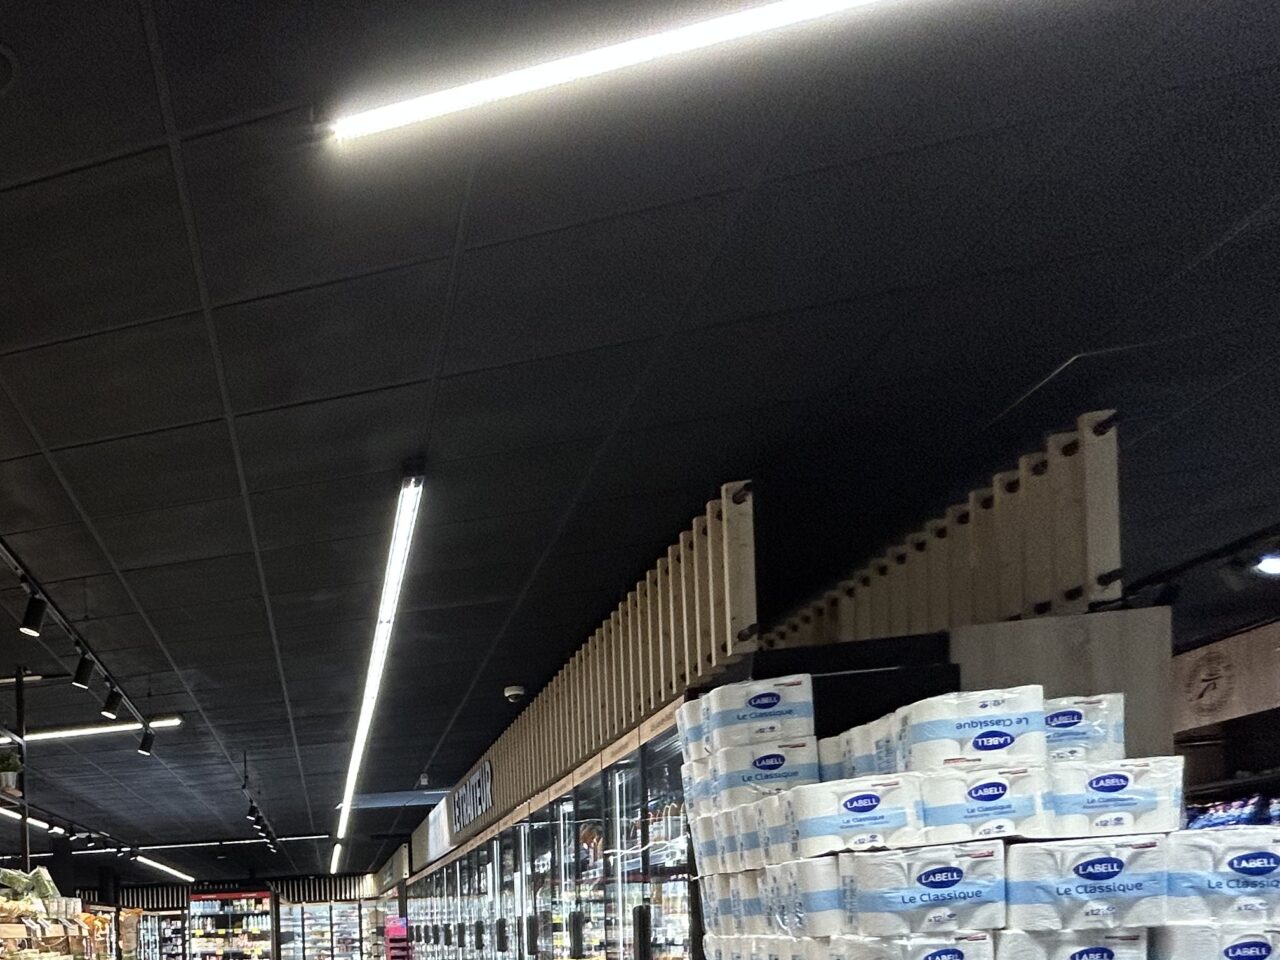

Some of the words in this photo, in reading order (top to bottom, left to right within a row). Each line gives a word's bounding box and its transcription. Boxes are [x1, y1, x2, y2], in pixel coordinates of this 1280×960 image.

[750, 696, 779, 706] LABELL
[955, 719, 1013, 731] Classique
[1015, 717, 1030, 726] Le
[975, 735, 1012, 746] LABELL
[754, 758, 784, 767] LABELL
[970, 785, 1005, 797] LABELL
[845, 797, 879, 809] LABELL
[1232, 855, 1278, 869] LABELL
[1078, 863, 1122, 876] LABELL
[921, 871, 961, 884] LABELL
[1056, 886, 1073, 896] Le
[1074, 880, 1144, 895] Classique
[1206, 879, 1223, 890] Le
[1226, 878, 1280, 892] Classiq
[900, 894, 917, 905] Le
[919, 888, 983, 904] Classique
